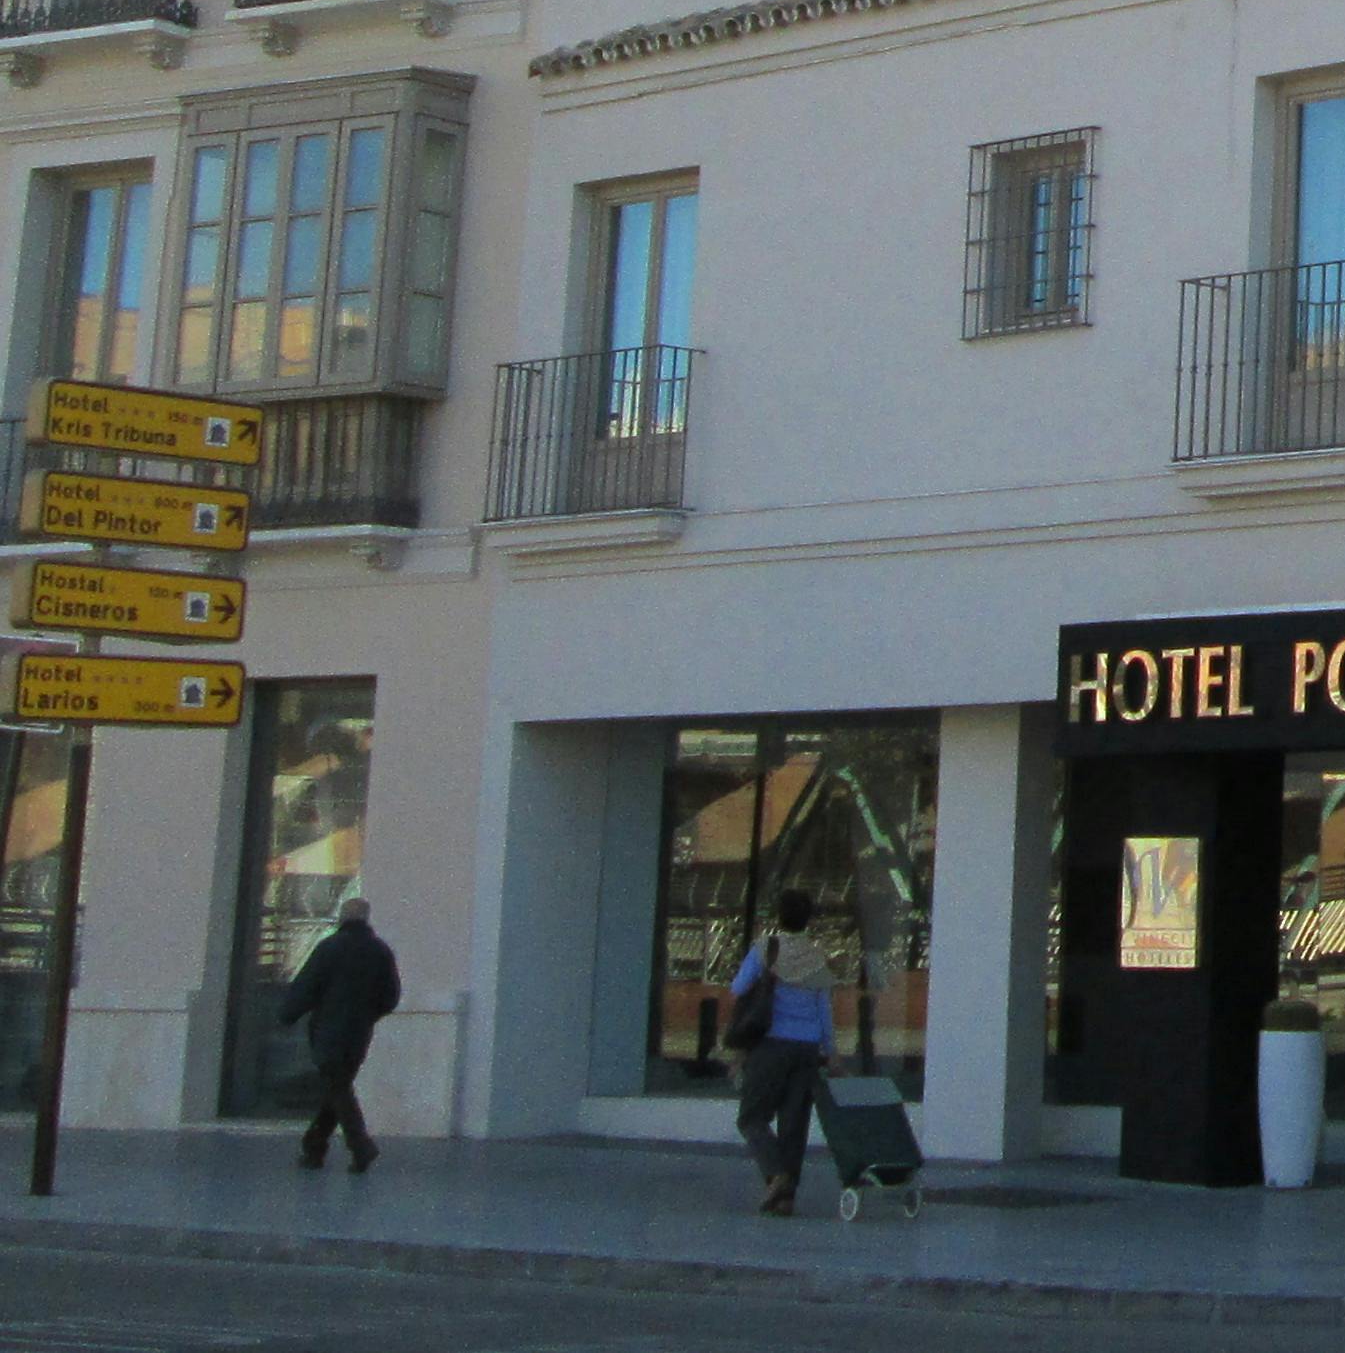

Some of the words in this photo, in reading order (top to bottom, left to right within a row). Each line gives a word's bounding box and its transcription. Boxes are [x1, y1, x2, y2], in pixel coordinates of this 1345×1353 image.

[54, 391, 109, 413] Hotel
[51, 417, 93, 438] Kris
[102, 421, 177, 446] Tribuna
[49, 481, 100, 502] Hotel
[46, 505, 83, 528] Del
[94, 510, 161, 534] Pintor
[40, 569, 104, 593] Hostal
[36, 595, 139, 621] Cisneros
[25, 665, 82, 682] Hotel
[1068, 644, 1254, 723] HOTEL
[22, 687, 99, 710] Larios
